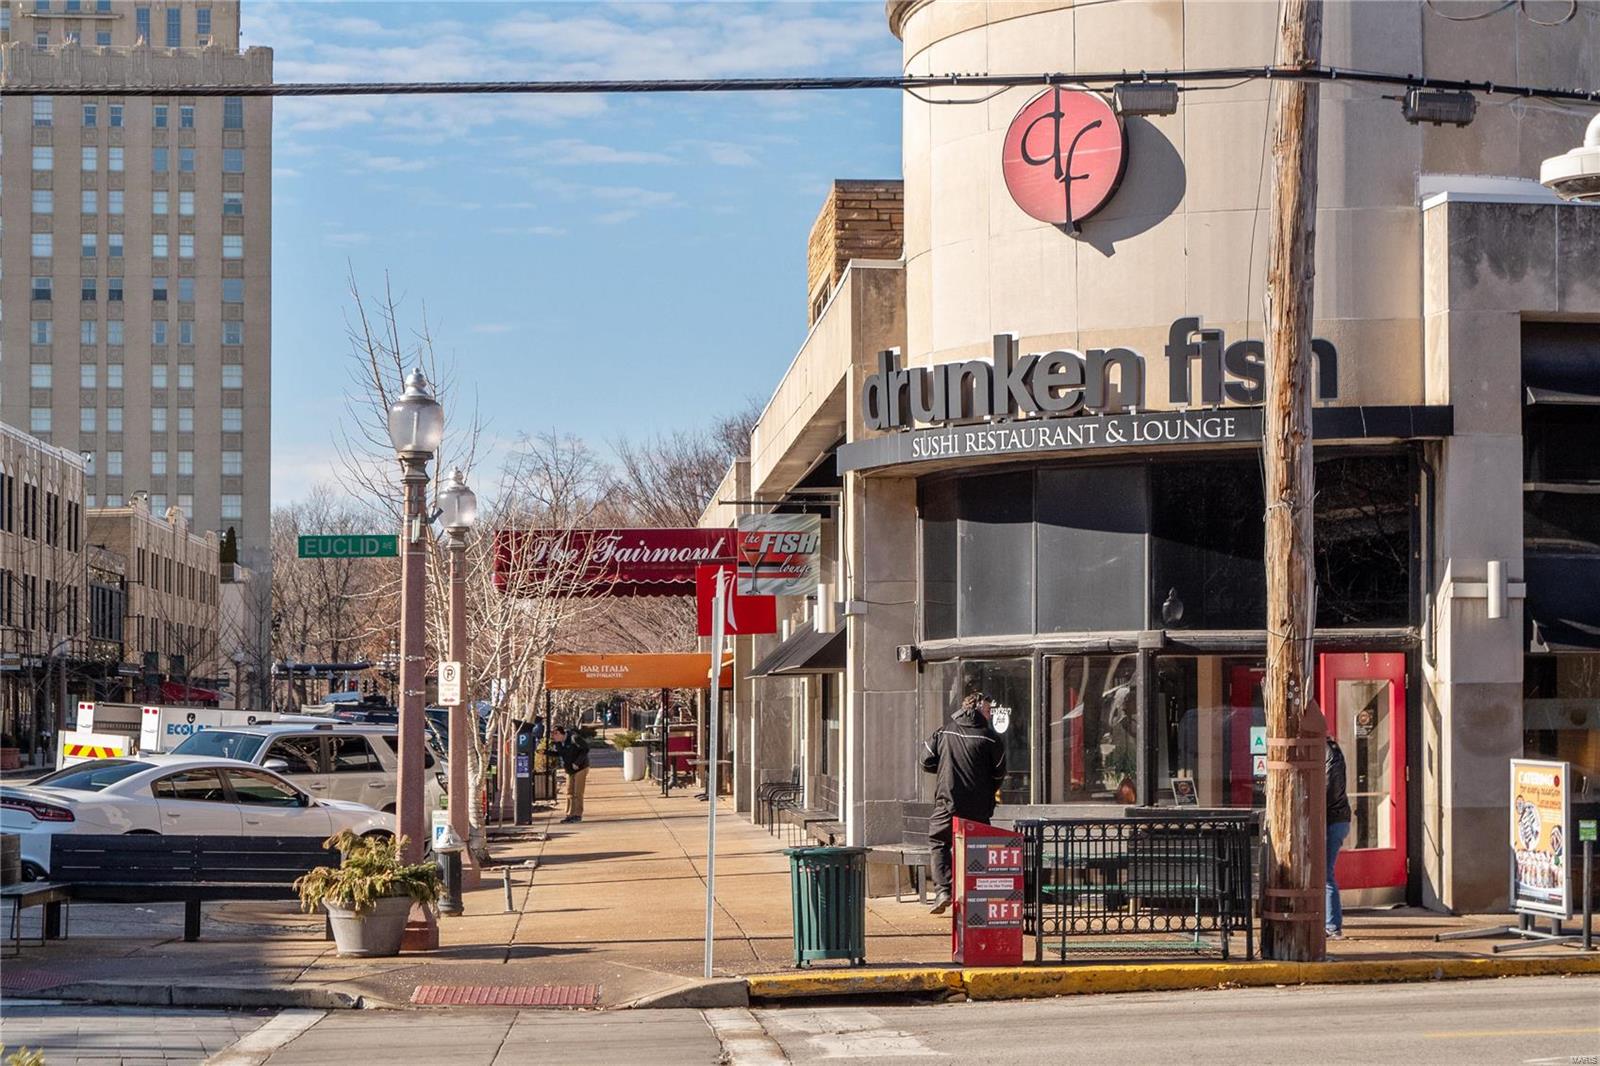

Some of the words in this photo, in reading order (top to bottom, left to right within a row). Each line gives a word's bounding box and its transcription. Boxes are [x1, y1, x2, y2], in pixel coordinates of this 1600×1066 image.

[862, 334, 1143, 430] drunken
[912, 435, 959, 458] SUSHI
[966, 423, 1099, 452] RESTAURANT
[1105, 420, 1127, 443] &
[1132, 417, 1236, 442] LOUNGE
[304, 538, 379, 555] EUCLID
[592, 535, 725, 563] Fairmont
[744, 531, 760, 544] the
[760, 533, 818, 554] FISH
[779, 554, 812, 586] lounge
[580, 664, 599, 673] BAR
[601, 664, 629, 673] ITALIA
[166, 723, 213, 735] ECOLA
[1255, 736, 1264, 746] A
[1257, 760, 1265, 770] A
[988, 850, 1020, 865] RFT
[988, 903, 1020, 918] RFT
